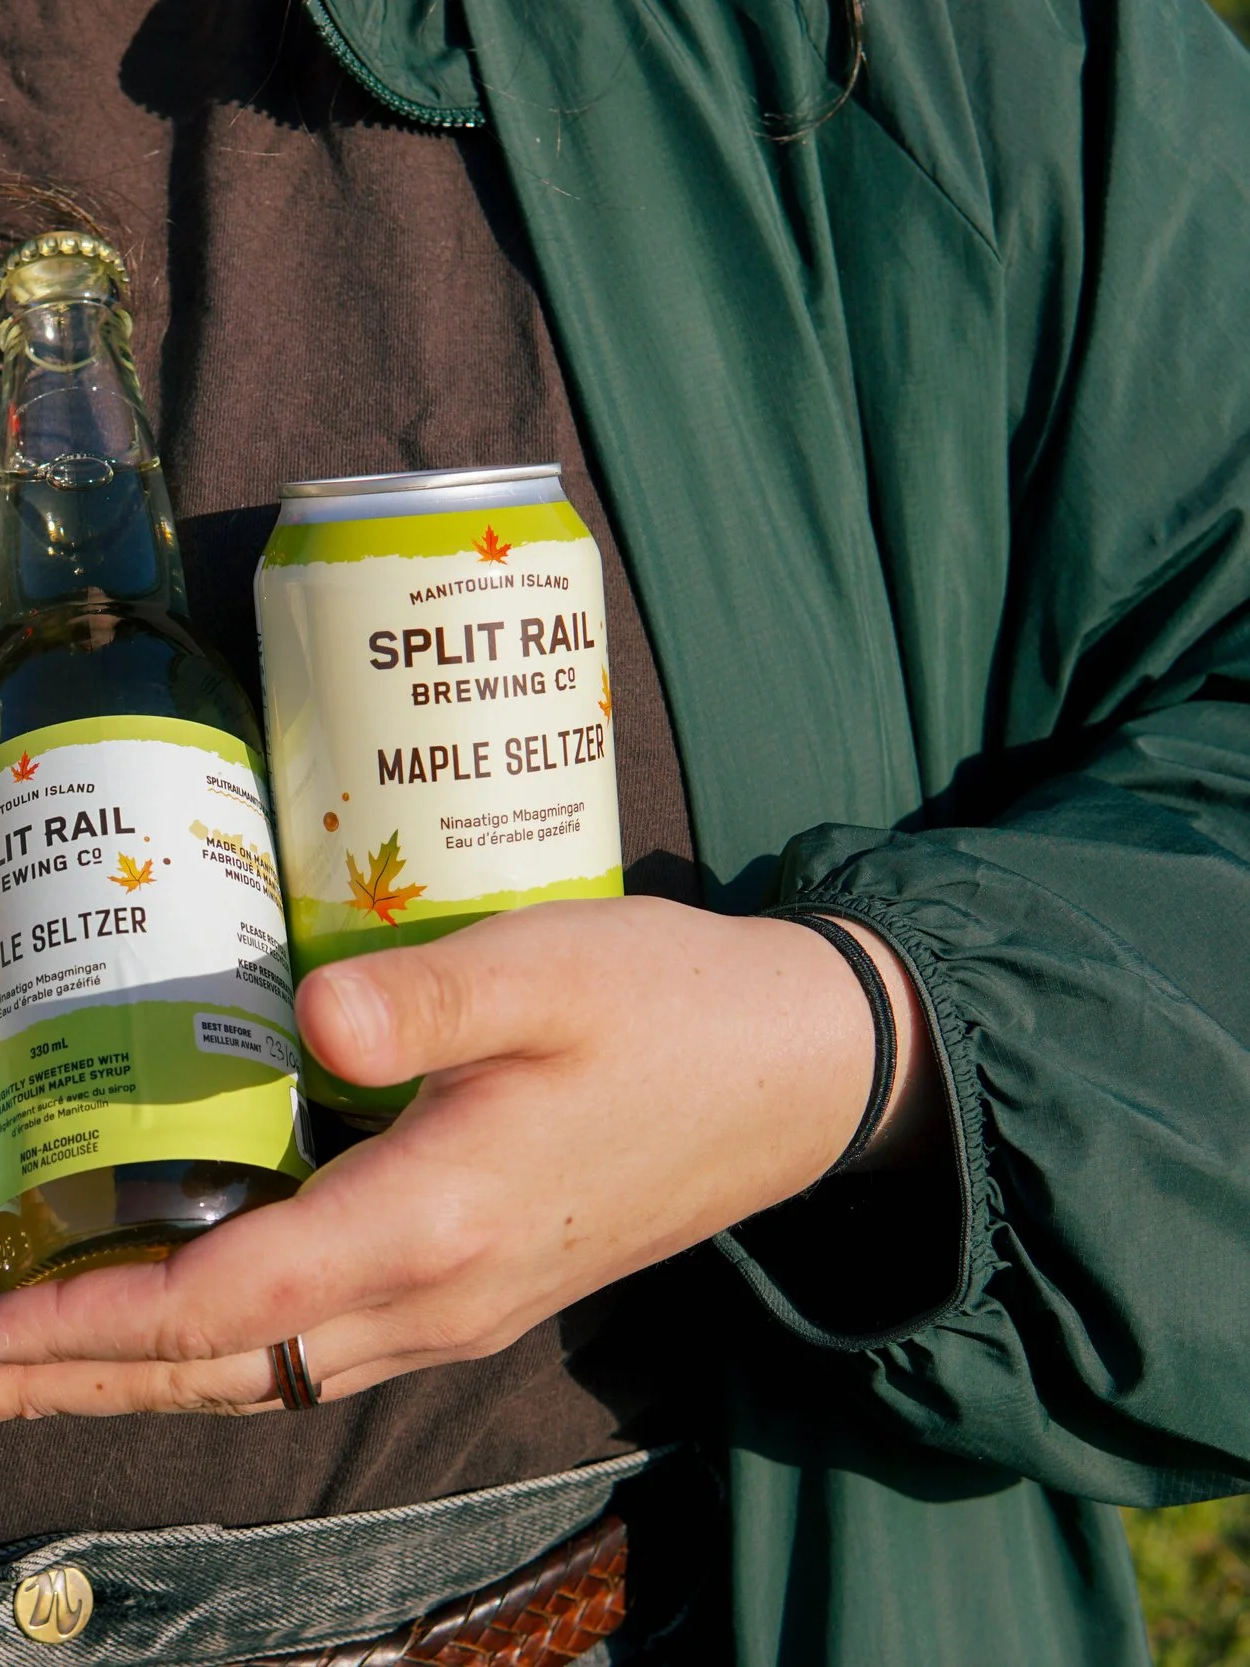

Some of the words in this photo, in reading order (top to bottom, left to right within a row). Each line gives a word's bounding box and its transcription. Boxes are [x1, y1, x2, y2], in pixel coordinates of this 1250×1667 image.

[409, 574, 515, 606] MANITOULIN
[521, 574, 569, 592] ISLAND
[368, 621, 505, 671] SPLIT
[520, 612, 595, 657] RAIL
[411, 671, 546, 707] BREWING
[377, 741, 491, 786] MAPLE
[505, 723, 605, 776] SELTZER
[45, 783, 96, 798] ISLAND
[44, 807, 136, 847] RAIL
[440, 810, 510, 833] Ninaatigo
[512, 801, 585, 824] Mbagmingan
[206, 836, 236, 854] MADE
[239, 847, 252, 861] ON
[445, 834, 474, 850] Eau
[477, 827, 535, 847] d'érable
[537, 818, 582, 841] gazéifié
[202, 849, 254, 875] FABRIQUÉ
[225, 868, 261, 892] MNIDOO
[32, 906, 147, 953] SELTZER
[237, 932, 270, 955] VEUILLEZ
[240, 921, 266, 941] PLEASE
[35, 961, 107, 986] Mbagmingan
[238, 958, 258, 972] KEEP
[14, 987, 53, 1011] d'érable
[55, 975, 101, 998] gazéifié
[243, 970, 281, 998] CONSERVER
[202, 1021, 222, 1032] BEST
[224, 1025, 252, 1038] BEFORE
[203, 1034, 240, 1048] MEILLEUR
[241, 1040, 262, 1053] AVANT
[30, 1043, 50, 1060] 330
[51, 1038, 69, 1052] mL
[28, 1058, 94, 1086] SWEETENED
[98, 1052, 129, 1065] WITH
[49, 1073, 86, 1092] MAPLE
[90, 1065, 131, 1080] SYRUP
[37, 1095, 64, 1112] sucré
[66, 1090, 90, 1103] avec
[92, 1084, 106, 1097] du
[108, 1082, 137, 1097] sirop
[11, 1115, 42, 1138] d'érable
[43, 1110, 55, 1123] de
[57, 1100, 109, 1118] Manitoulin
[20, 1129, 100, 1164] NON-ALCOHOLIC
[21, 1160, 39, 1175] NON
[40, 1141, 99, 1167] ALCOOLISÉE
